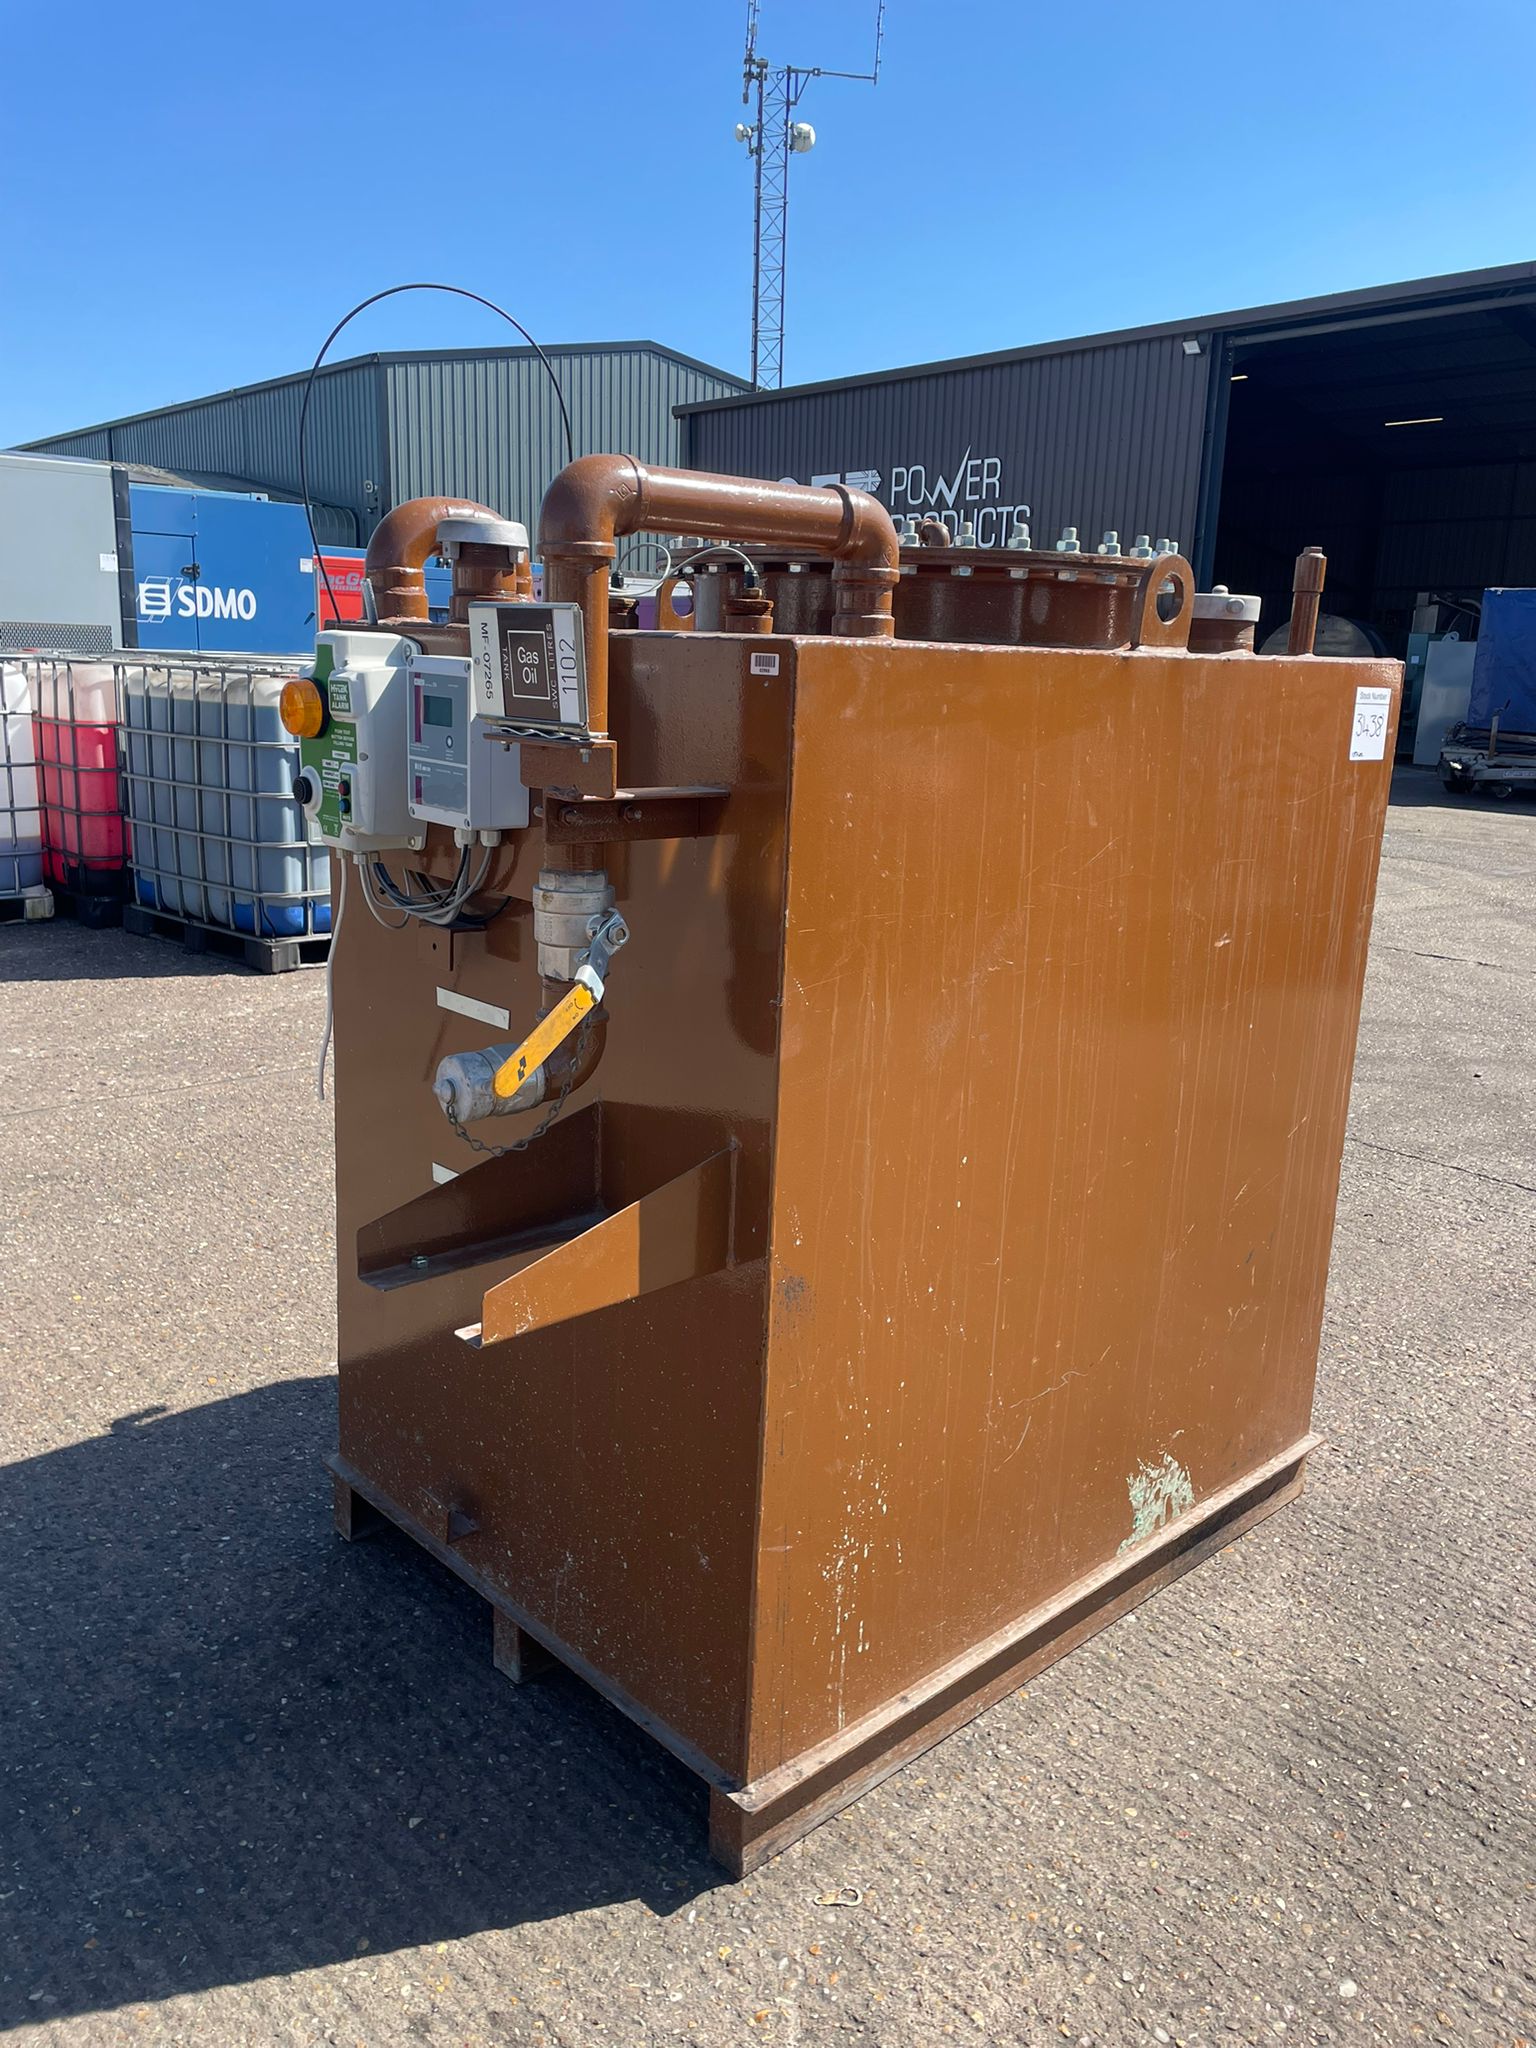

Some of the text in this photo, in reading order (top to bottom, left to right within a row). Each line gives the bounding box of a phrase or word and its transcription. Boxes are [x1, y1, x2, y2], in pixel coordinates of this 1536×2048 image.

[890, 444, 1002, 508] POWER
[177, 585, 257, 621] SDMO
[480, 622, 494, 700] MF-07265
[501, 647, 510, 681] TANK
[517, 646, 539, 665] Gas
[522, 666, 538, 685] Oil
[545, 623, 559, 709] SWC LITRES
[559, 638, 578, 695] 1102
